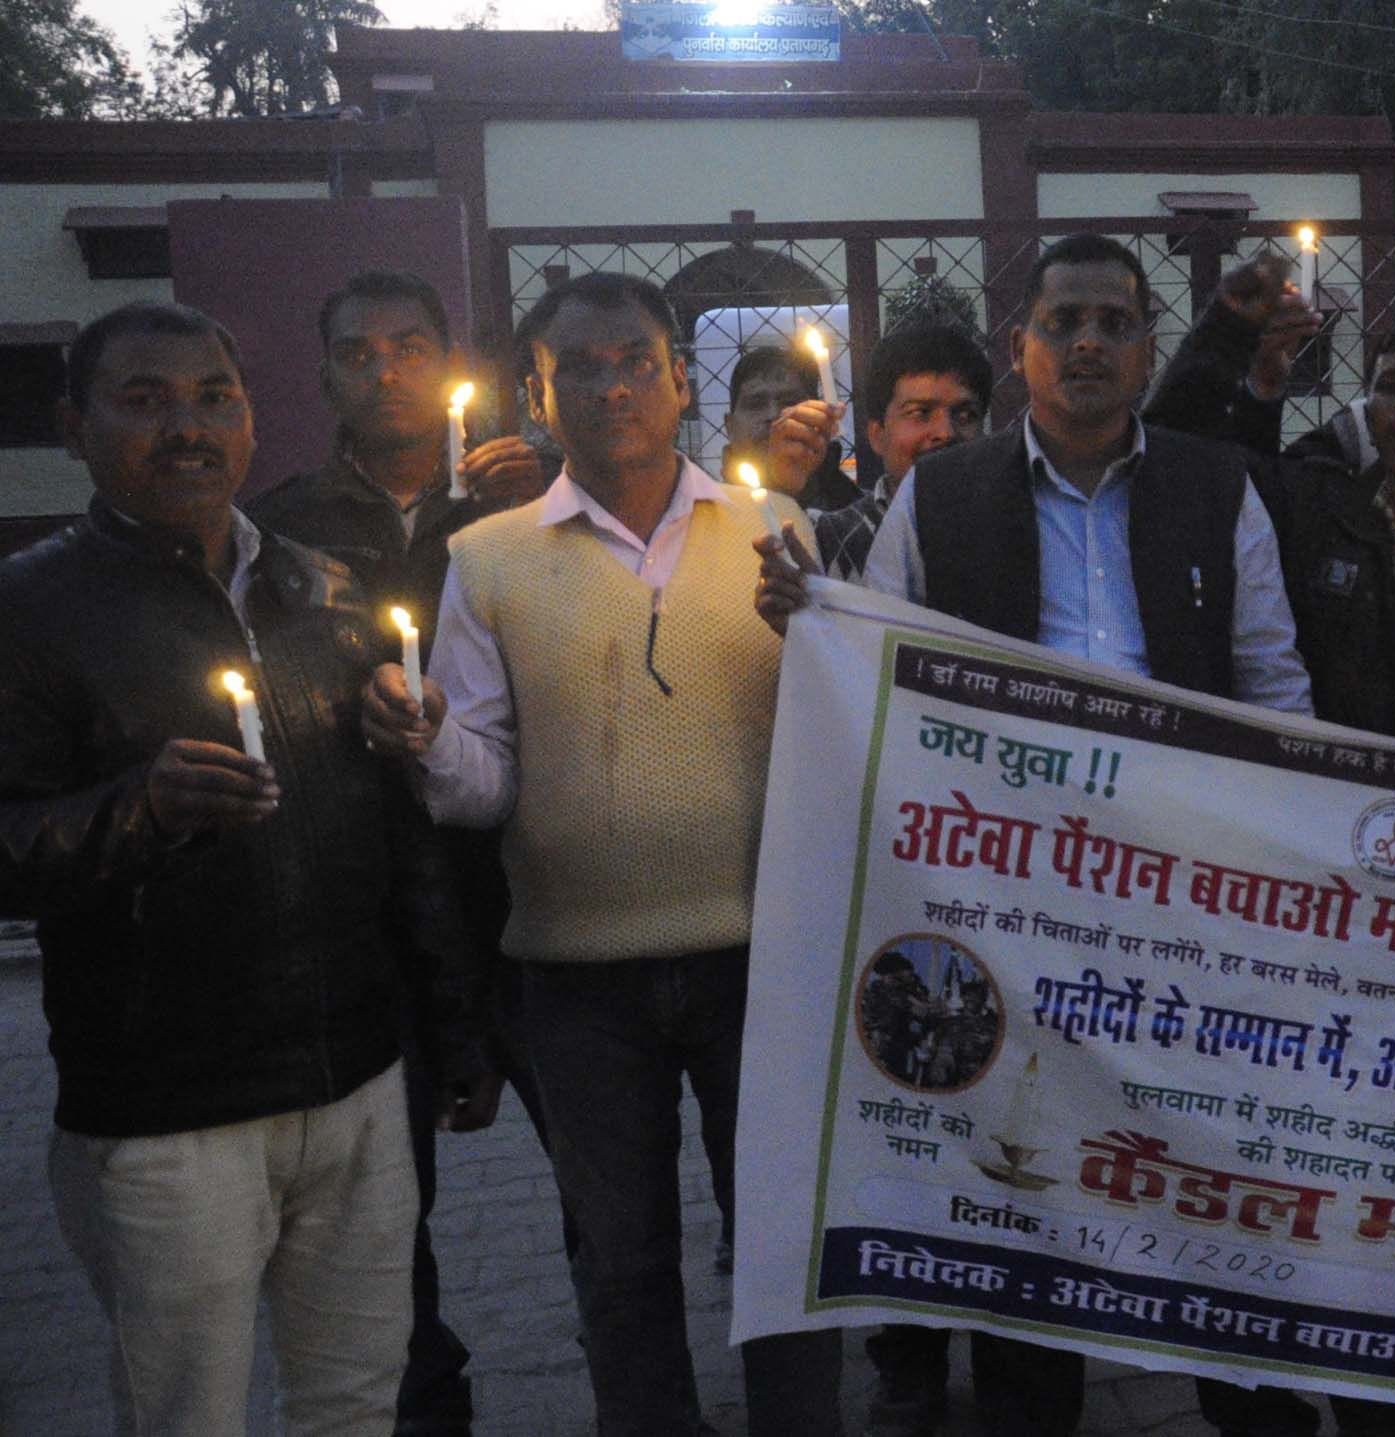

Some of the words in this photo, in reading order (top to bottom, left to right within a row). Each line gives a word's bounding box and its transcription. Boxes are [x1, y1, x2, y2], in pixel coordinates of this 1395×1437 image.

[728, 32, 777, 54] कार्यालय
[930, 664, 956, 686] डॉ
[961, 670, 997, 694] राम
[1007, 674, 1076, 709] आशीष
[1086, 694, 1132, 719] अमर
[1140, 699, 1167, 731] रहें
[919, 715, 988, 764] जय
[998, 736, 1072, 789] युवा
[892, 790, 1041, 880] अटेवा
[1052, 815, 1180, 906] पेंशन
[1190, 859, 1362, 942] बचाओ
[924, 899, 988, 932] शहीदों
[995, 909, 1025, 935] की
[1032, 911, 1111, 950] चिताओं
[1119, 935, 1145, 958] पर
[1219, 951, 1244, 977] हर
[1251, 959, 1299, 985] बरस
[1032, 967, 1145, 1045] शहीदों
[1150, 984, 1190, 1048] के
[1193, 1003, 1315, 1072] सम्मान
[858, 1097, 934, 1132] शहीदों
[940, 1113, 975, 1141] को
[1120, 1079, 1227, 1118] पुलवामा
[1235, 1092, 1256, 1122] में
[1266, 1102, 1336, 1139] शहीद
[885, 1135, 941, 1164] नमन
[1237, 1134, 1273, 1164] की
[1283, 1142, 1371, 1182] शहादत
[950, 1195, 1042, 1234] दिनांक
[1077, 1129, 1338, 1242] कैंडल
[857, 1240, 1010, 1293] निवेदक
[1049, 1274, 1170, 1323] अटेवा
[1179, 1295, 1286, 1343] पेंशन
